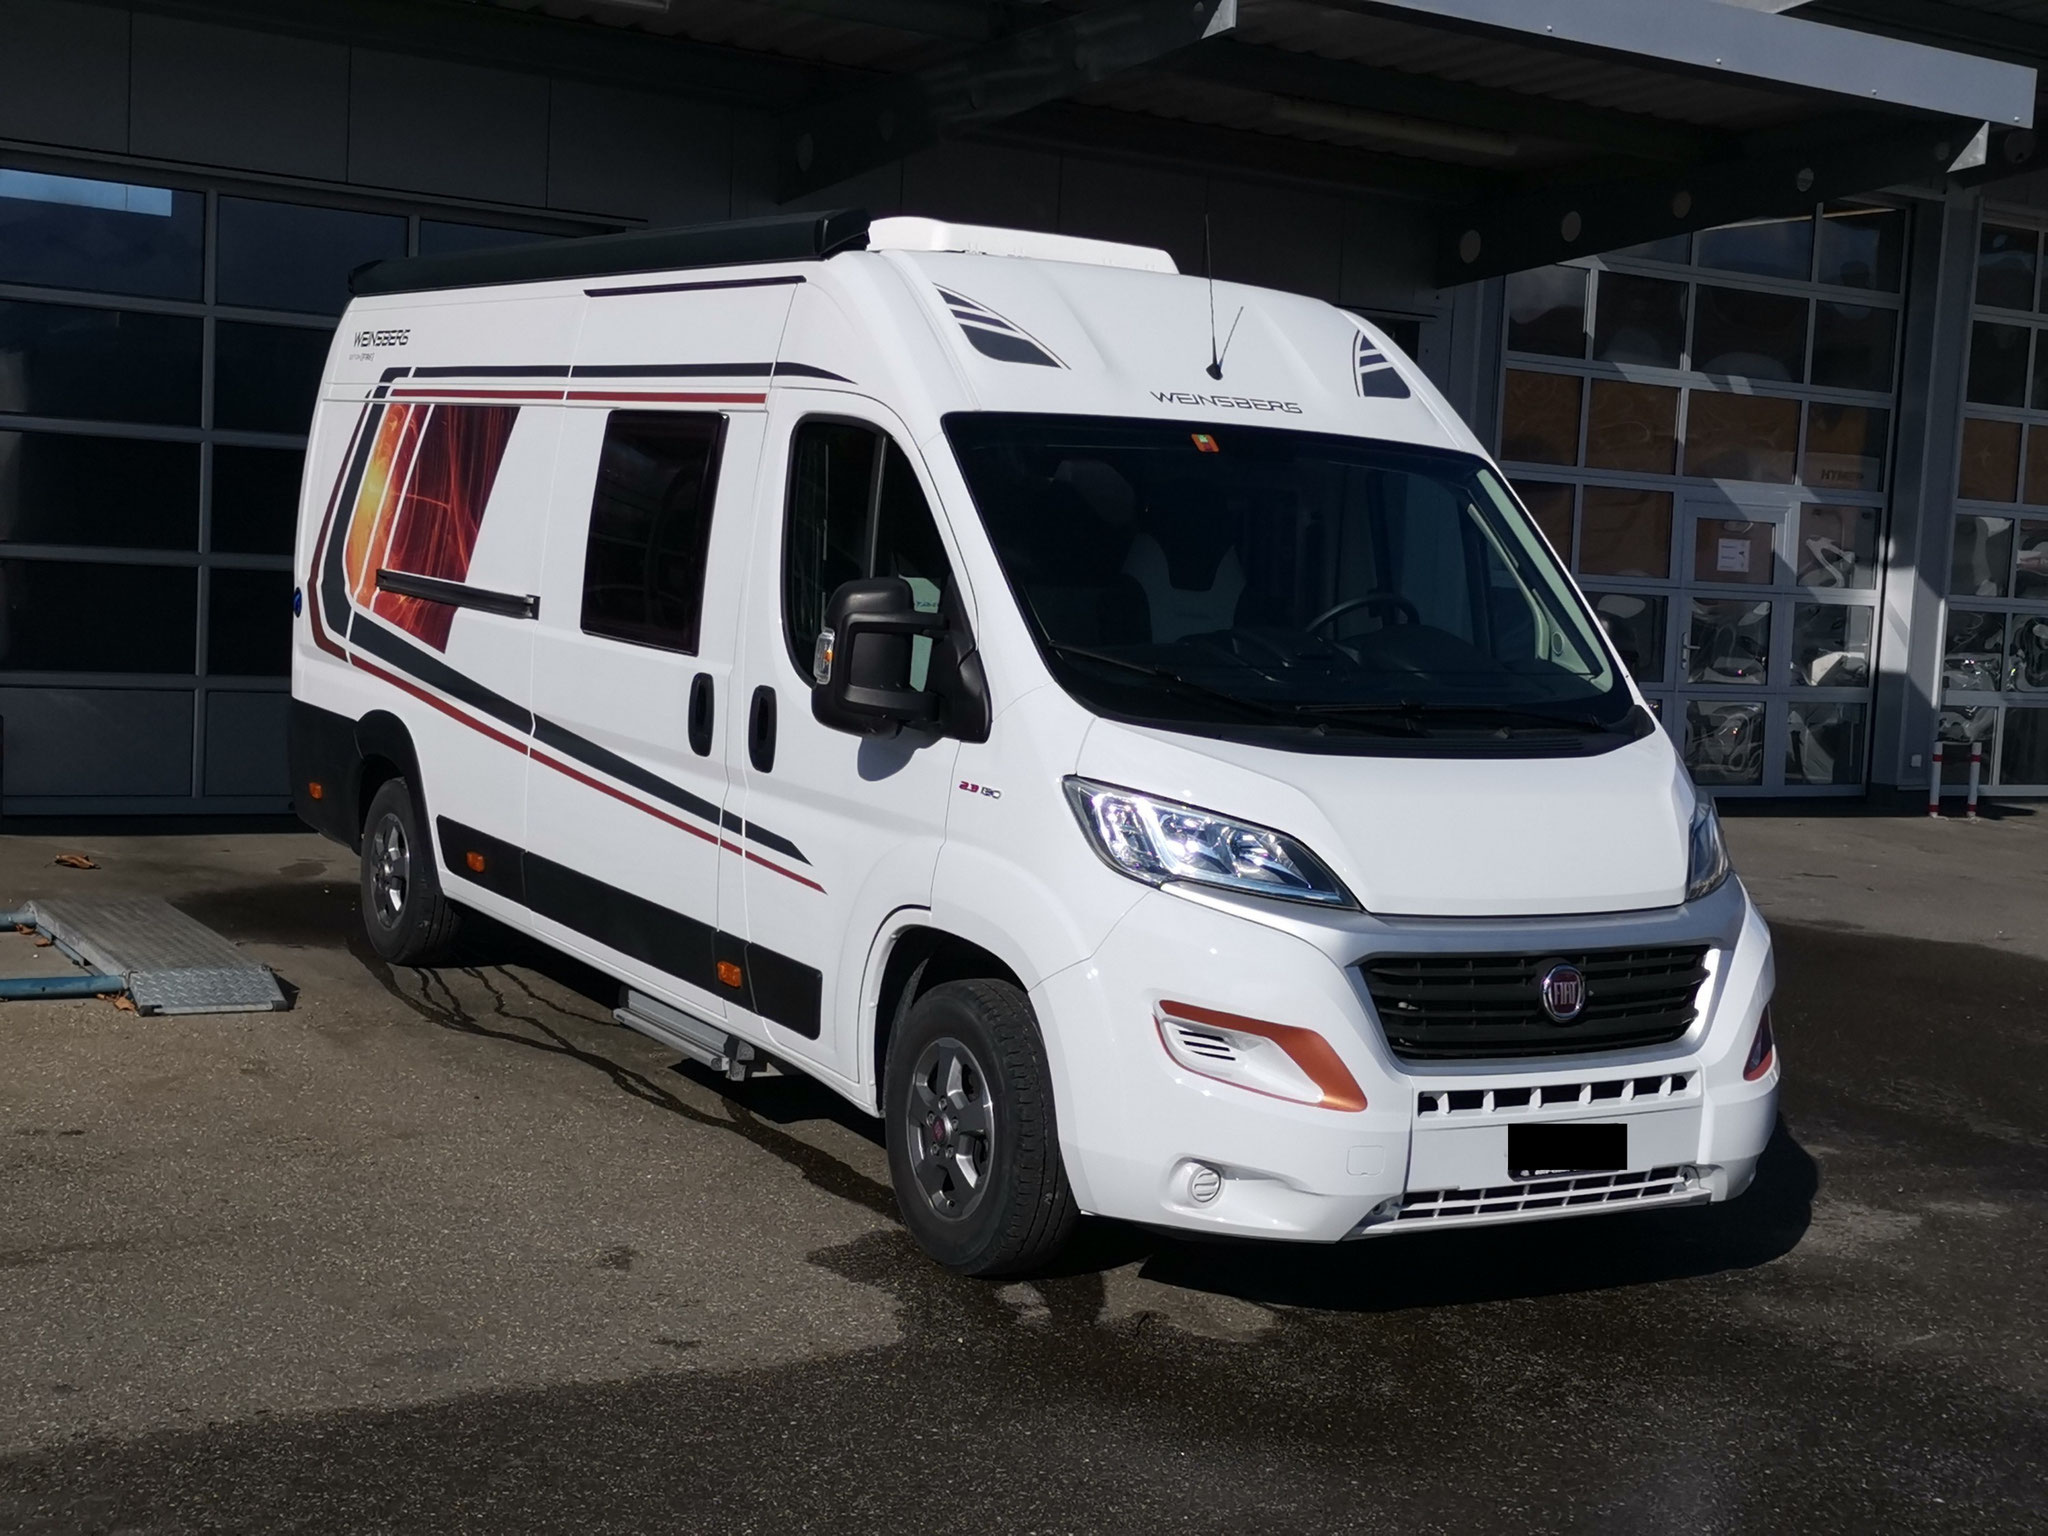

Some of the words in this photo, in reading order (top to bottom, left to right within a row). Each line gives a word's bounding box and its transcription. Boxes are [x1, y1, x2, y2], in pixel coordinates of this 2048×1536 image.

[353, 329, 410, 347] WEINSBERG
[1150, 391, 1302, 414] WEINSBERG
[1553, 982, 1577, 1005] FIAT
